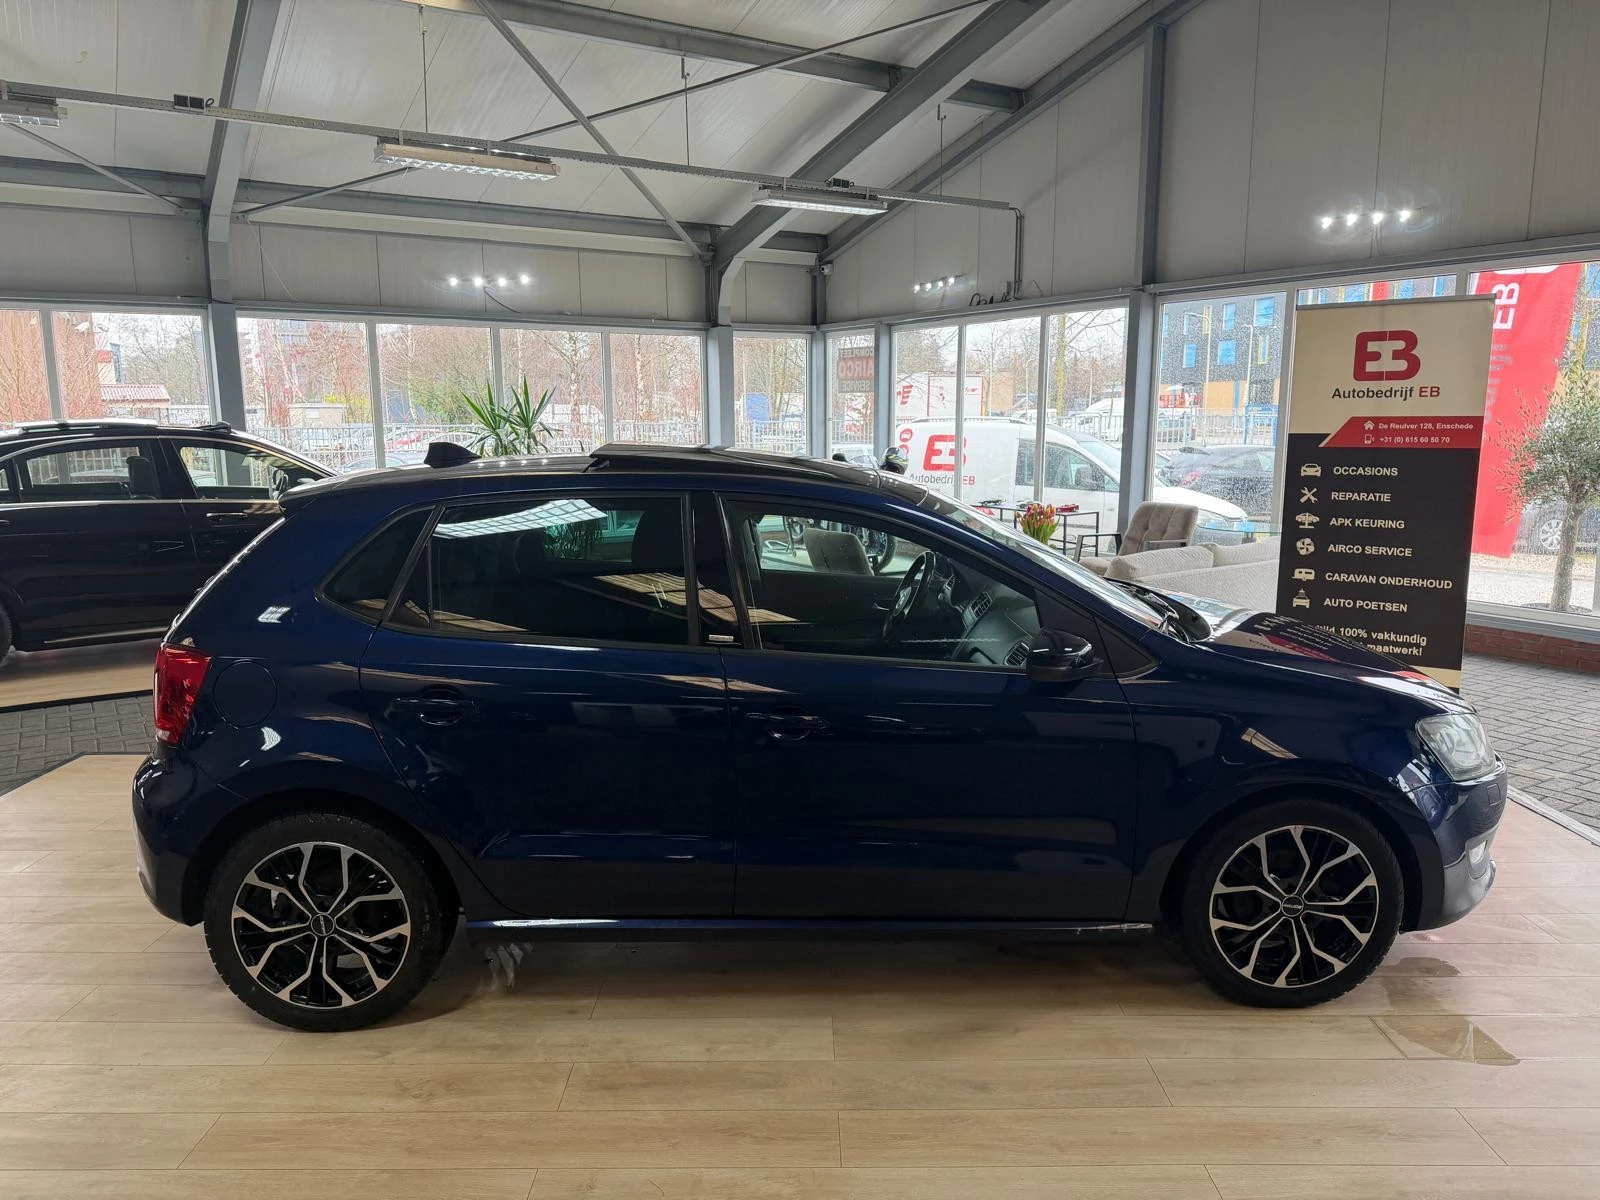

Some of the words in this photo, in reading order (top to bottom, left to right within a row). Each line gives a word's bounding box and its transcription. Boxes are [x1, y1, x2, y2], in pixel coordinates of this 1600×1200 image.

[1353, 329, 1421, 382] EB
[1331, 386, 1414, 401] Autobedrijf
[1419, 386, 1440, 398] EB
[1378, 422, 1389, 430] De
[1419, 422, 1435, 431] 128,
[1436, 422, 1474, 430] Enschede
[1379, 436, 1392, 444] +31
[1394, 436, 1404, 444] (0)
[1405, 436, 1418, 444] 615
[1420, 436, 1429, 444] 60
[1430, 436, 1440, 444] 50
[1441, 436, 1450, 444] 70
[1333, 466, 1398, 476] OCCASIONS
[963, 475, 976, 486] EB
[1331, 491, 1392, 502] REPARATIE
[1329, 517, 1352, 527] APK
[1355, 519, 1405, 529] KEURING
[1328, 544, 1362, 554] AIRCO
[1364, 546, 1413, 557] SERVICE
[1325, 572, 1376, 585] CARAVAN
[1379, 576, 1453, 589] ONDERHOUD
[1323, 598, 1354, 608] AUTO
[1356, 600, 1408, 612] POETSEN
[1339, 627, 1368, 638] 100%
[1371, 631, 1427, 646] vakkundig
[1367, 643, 1422, 656] maatwerk!
